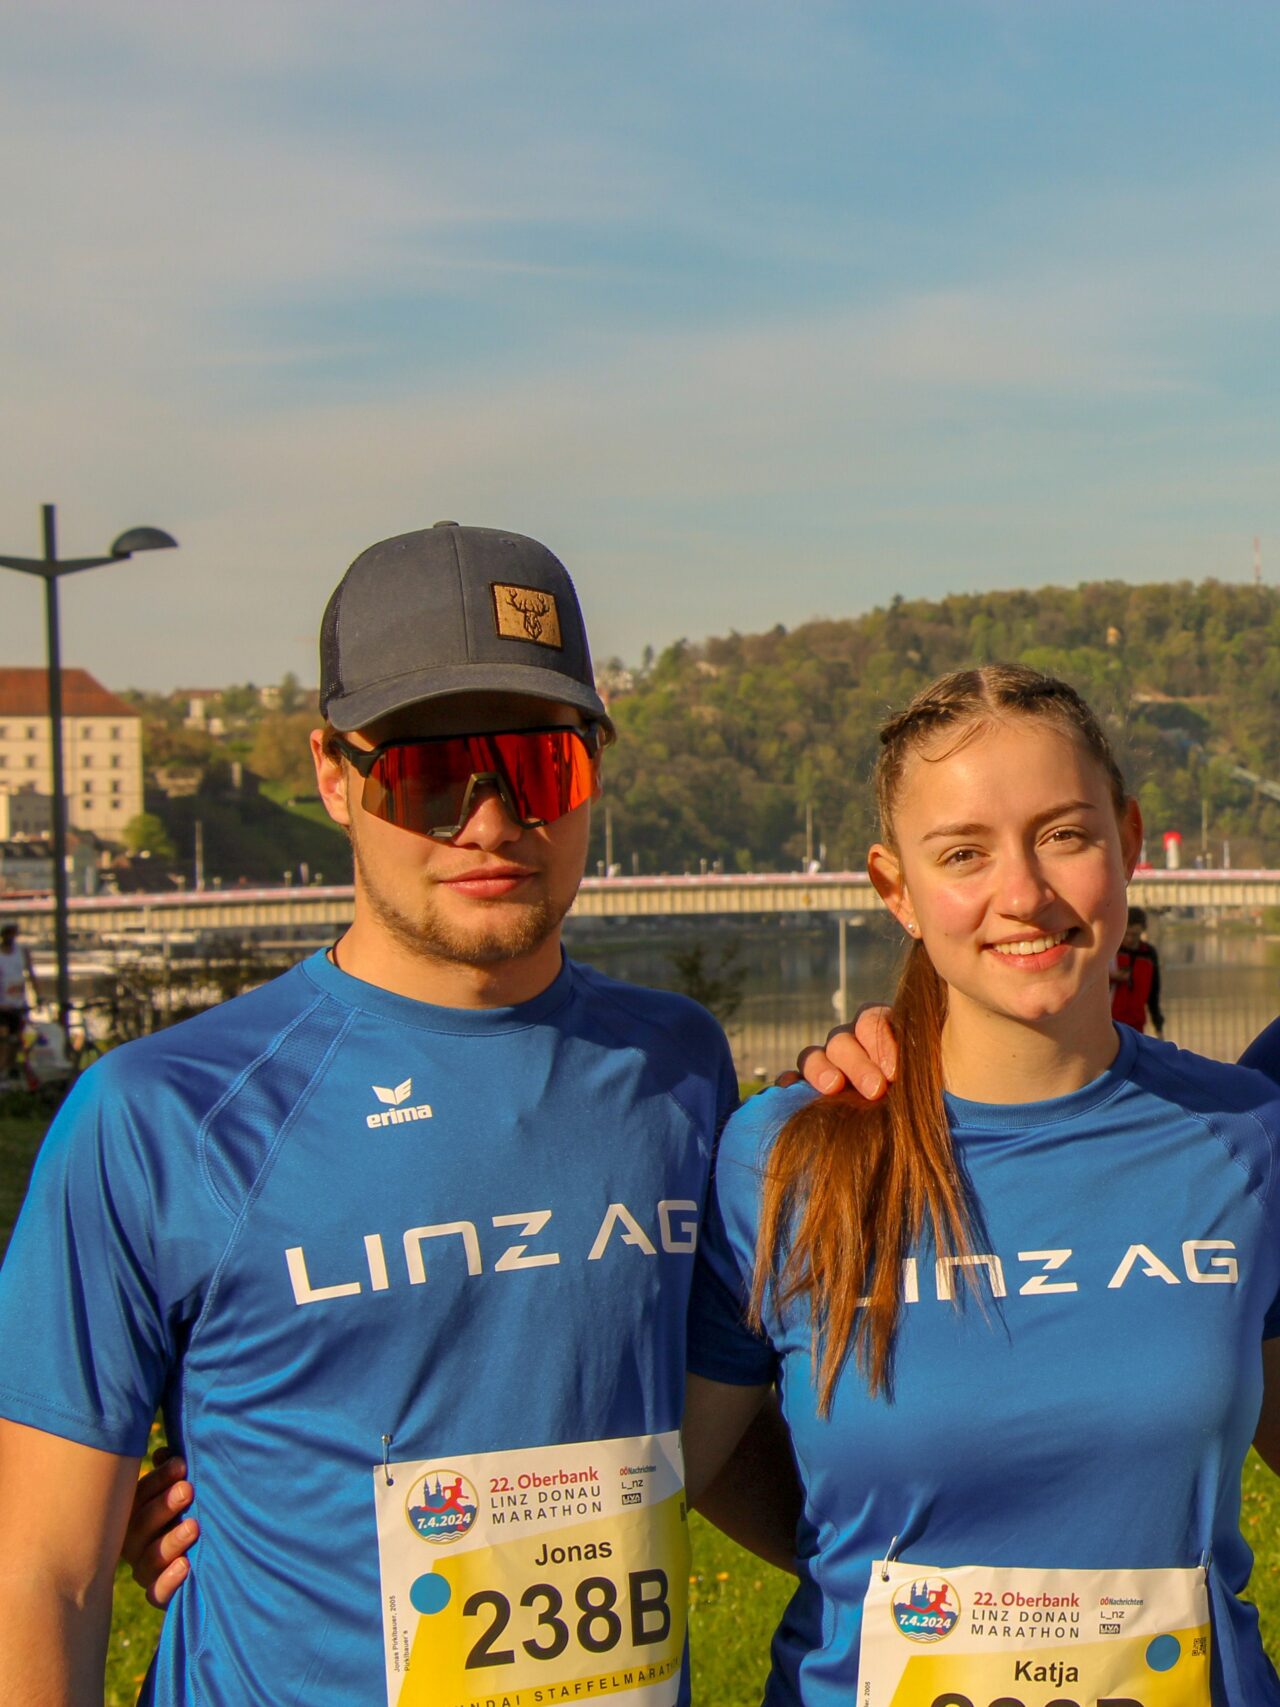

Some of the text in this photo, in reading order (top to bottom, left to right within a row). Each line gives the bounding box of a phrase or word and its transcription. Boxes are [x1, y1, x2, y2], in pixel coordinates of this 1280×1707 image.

[366, 1104, 433, 1129] erima
[285, 1200, 698, 1306] LINZ AG
[855, 1239, 1239, 1308] INZ AG
[489, 1466, 599, 1494] 22. Oberbank
[490, 1485, 601, 1509] LINZ DONAU
[417, 1513, 471, 1529] 7.4.2024
[492, 1501, 602, 1525] MARATHON
[534, 1541, 613, 1566] Jonas
[973, 1592, 1080, 1608] 22. Oberbank
[462, 1568, 671, 1670] 238B
[899, 1614, 951, 1629] 7.4.2024
[971, 1610, 1080, 1623] LINZ DONAU
[971, 1624, 1079, 1638] MARATHON
[1014, 1660, 1079, 1687] Katja
